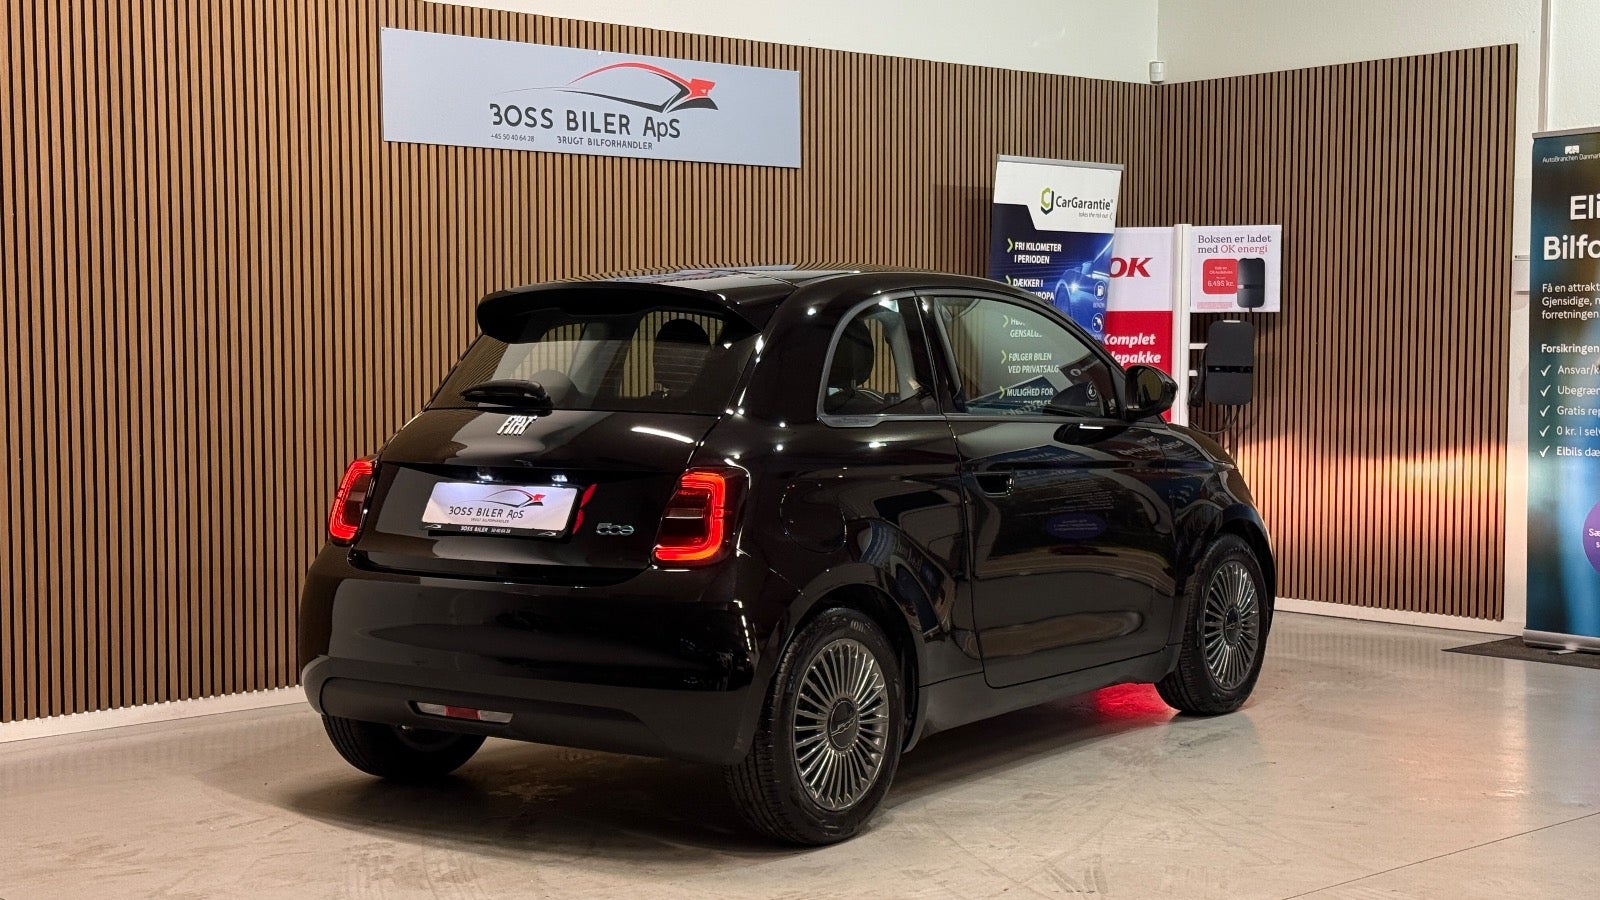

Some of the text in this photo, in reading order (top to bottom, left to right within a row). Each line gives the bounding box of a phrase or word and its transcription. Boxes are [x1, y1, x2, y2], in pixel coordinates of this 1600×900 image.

[566, 110, 631, 135] BILER
[643, 116, 680, 142] ApS
[588, 138, 653, 149] BILFORHANDLER
[1056, 196, 1110, 210] CarGarantie
[1198, 235, 1232, 243] Boksen
[1247, 234, 1272, 243] ladet
[1015, 242, 1062, 252] FRI KILOMETER
[1198, 245, 1268, 254] med OK energi
[1018, 255, 1050, 264] PERIODEN
[1109, 257, 1153, 278] OK
[1013, 278, 1040, 287] DÆKKER
[1542, 283, 1553, 293] Få
[1554, 285, 1566, 293] en
[1541, 296, 1592, 308] Gjensidige,
[1542, 310, 1599, 320] forretningen
[1541, 343, 1600, 355] Forsikringen
[1008, 352, 1052, 361] FØLGER BILEN
[1008, 364, 1059, 373] VED PRIVATSALG
[1007, 388, 1054, 397] MULIGHED FOR
[1556, 405, 1586, 416] Gratis
[496, 415, 538, 434] FIAT
[1565, 426, 1577, 436] kr.
[1556, 446, 1583, 456] Elbils
[476, 507, 504, 518] BILER
[507, 509, 524, 520] ApS
